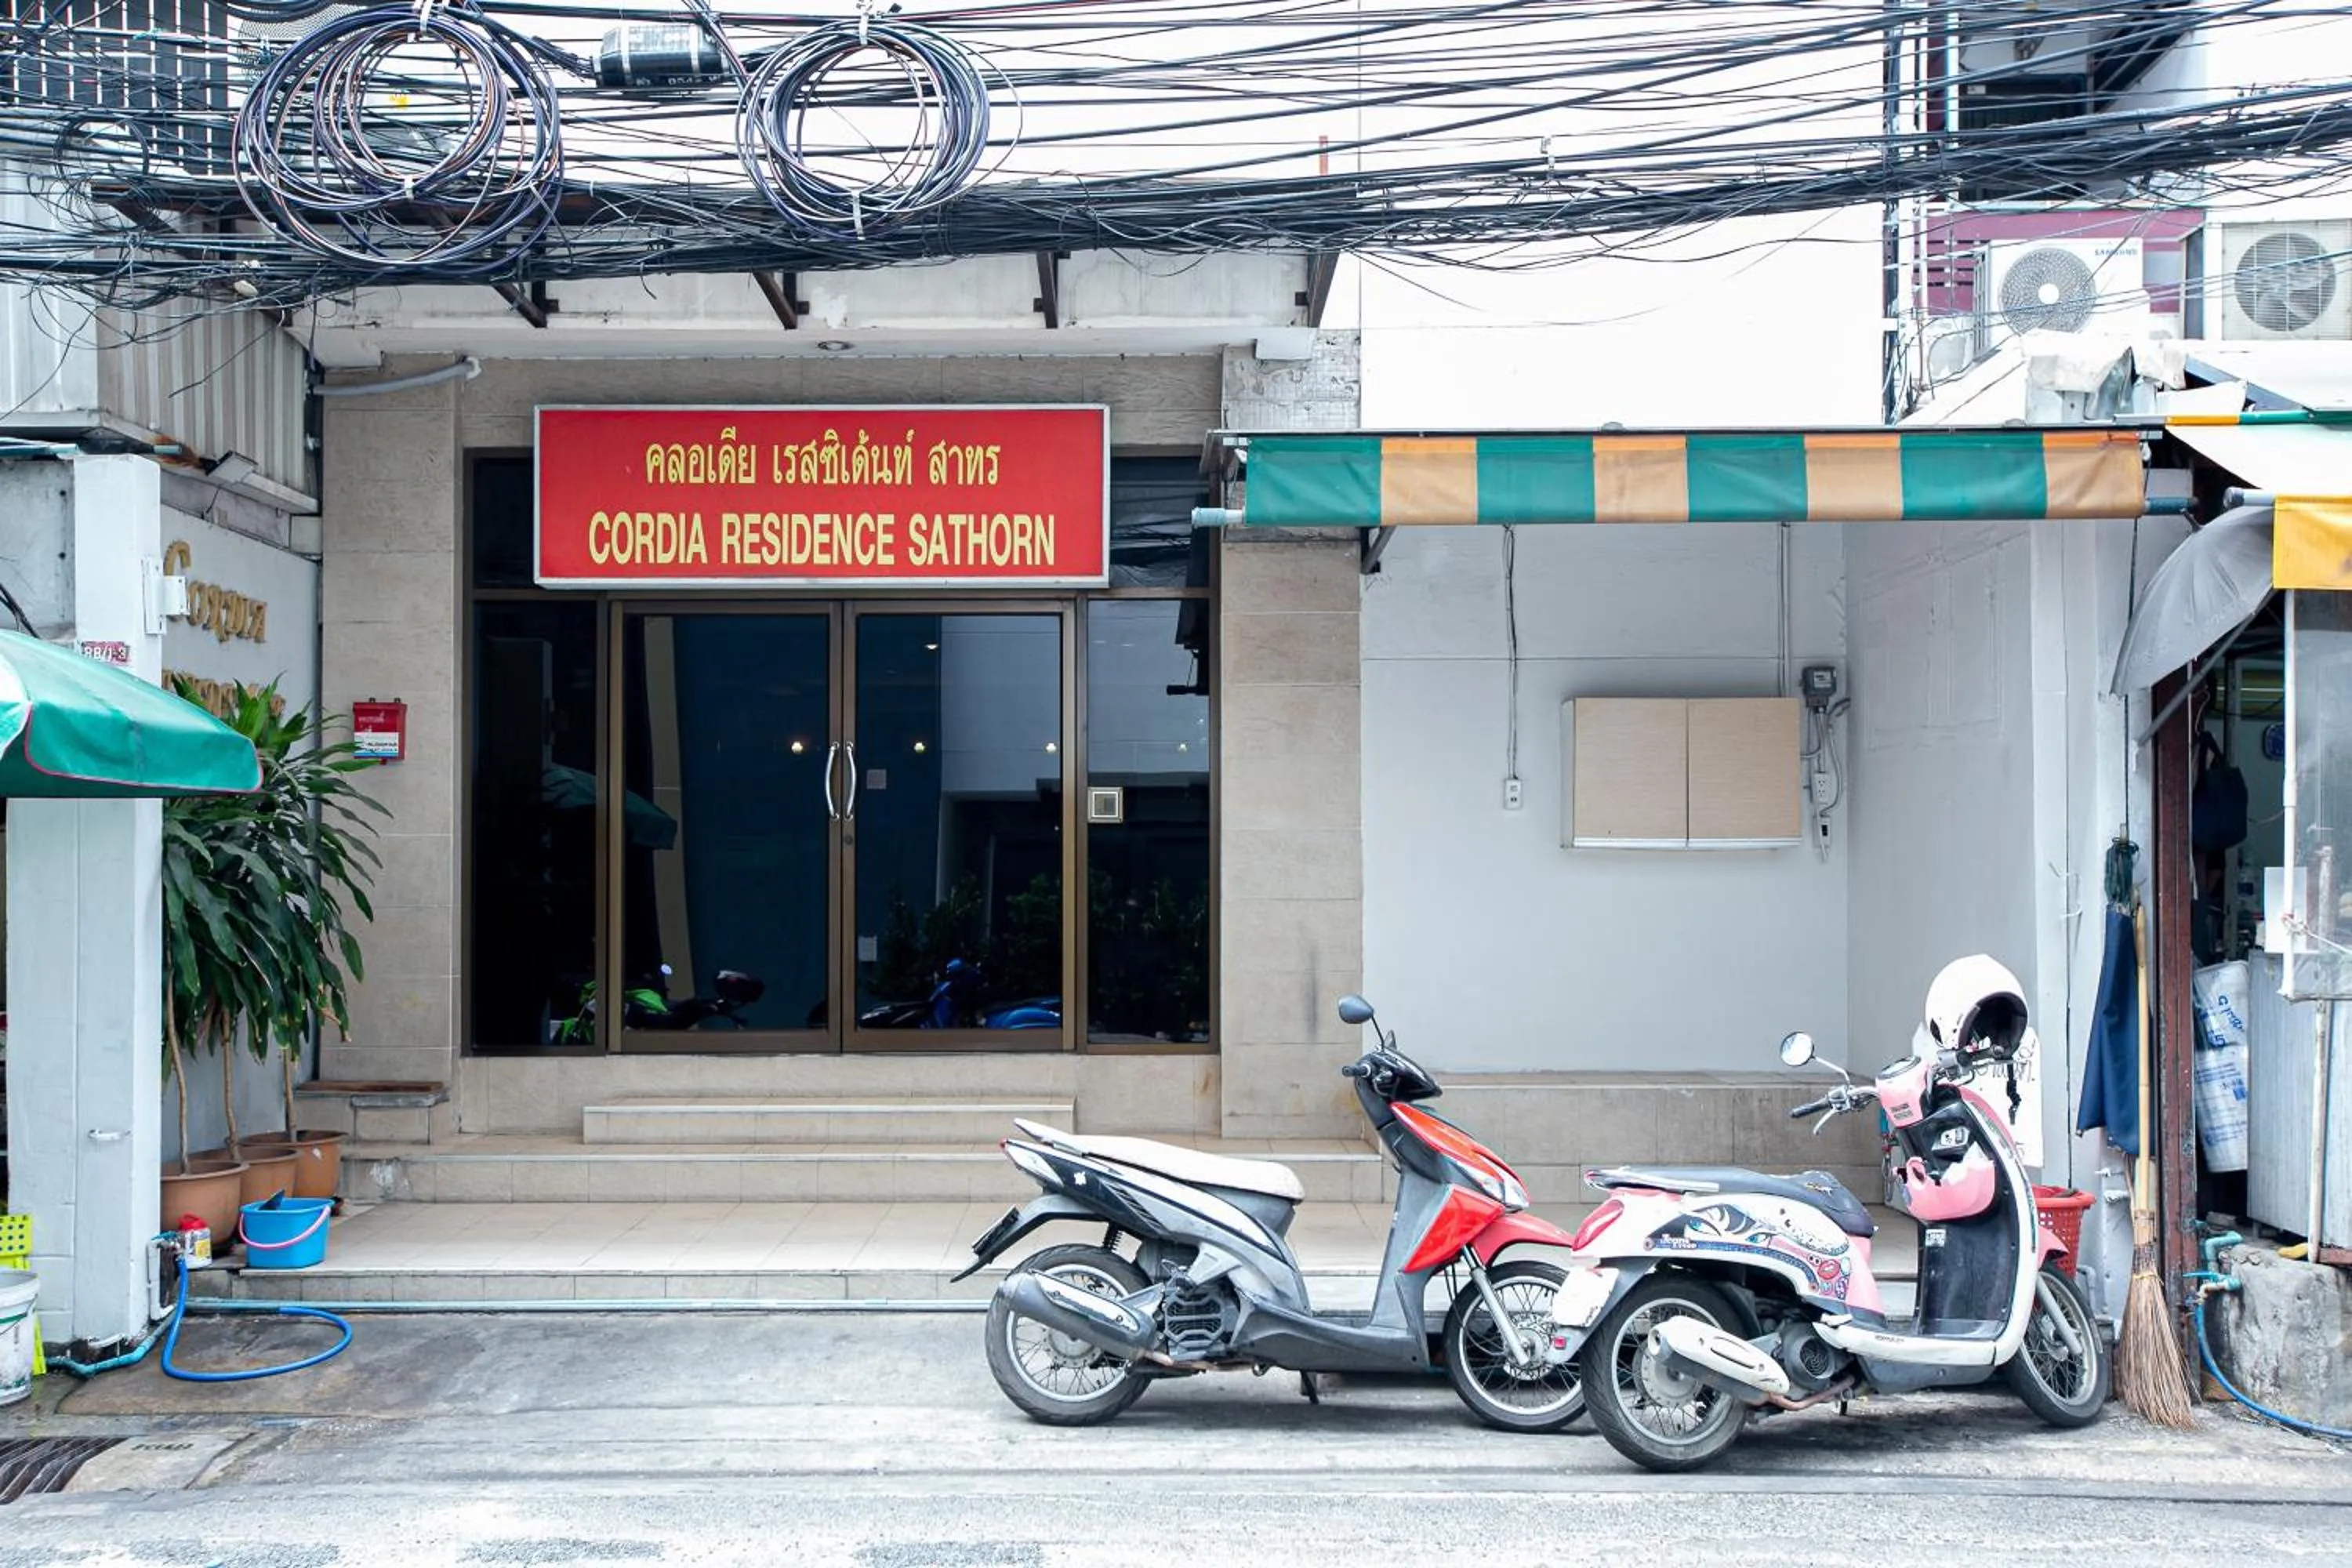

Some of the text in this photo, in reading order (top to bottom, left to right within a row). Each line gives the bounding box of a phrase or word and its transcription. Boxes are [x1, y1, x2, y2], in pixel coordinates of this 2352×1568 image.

[646, 426, 1001, 485] คลอเดีย เรสซิเด้นท์ สาทร
[589, 511, 1055, 566] CORDIA RESIDENCE SATHORN
